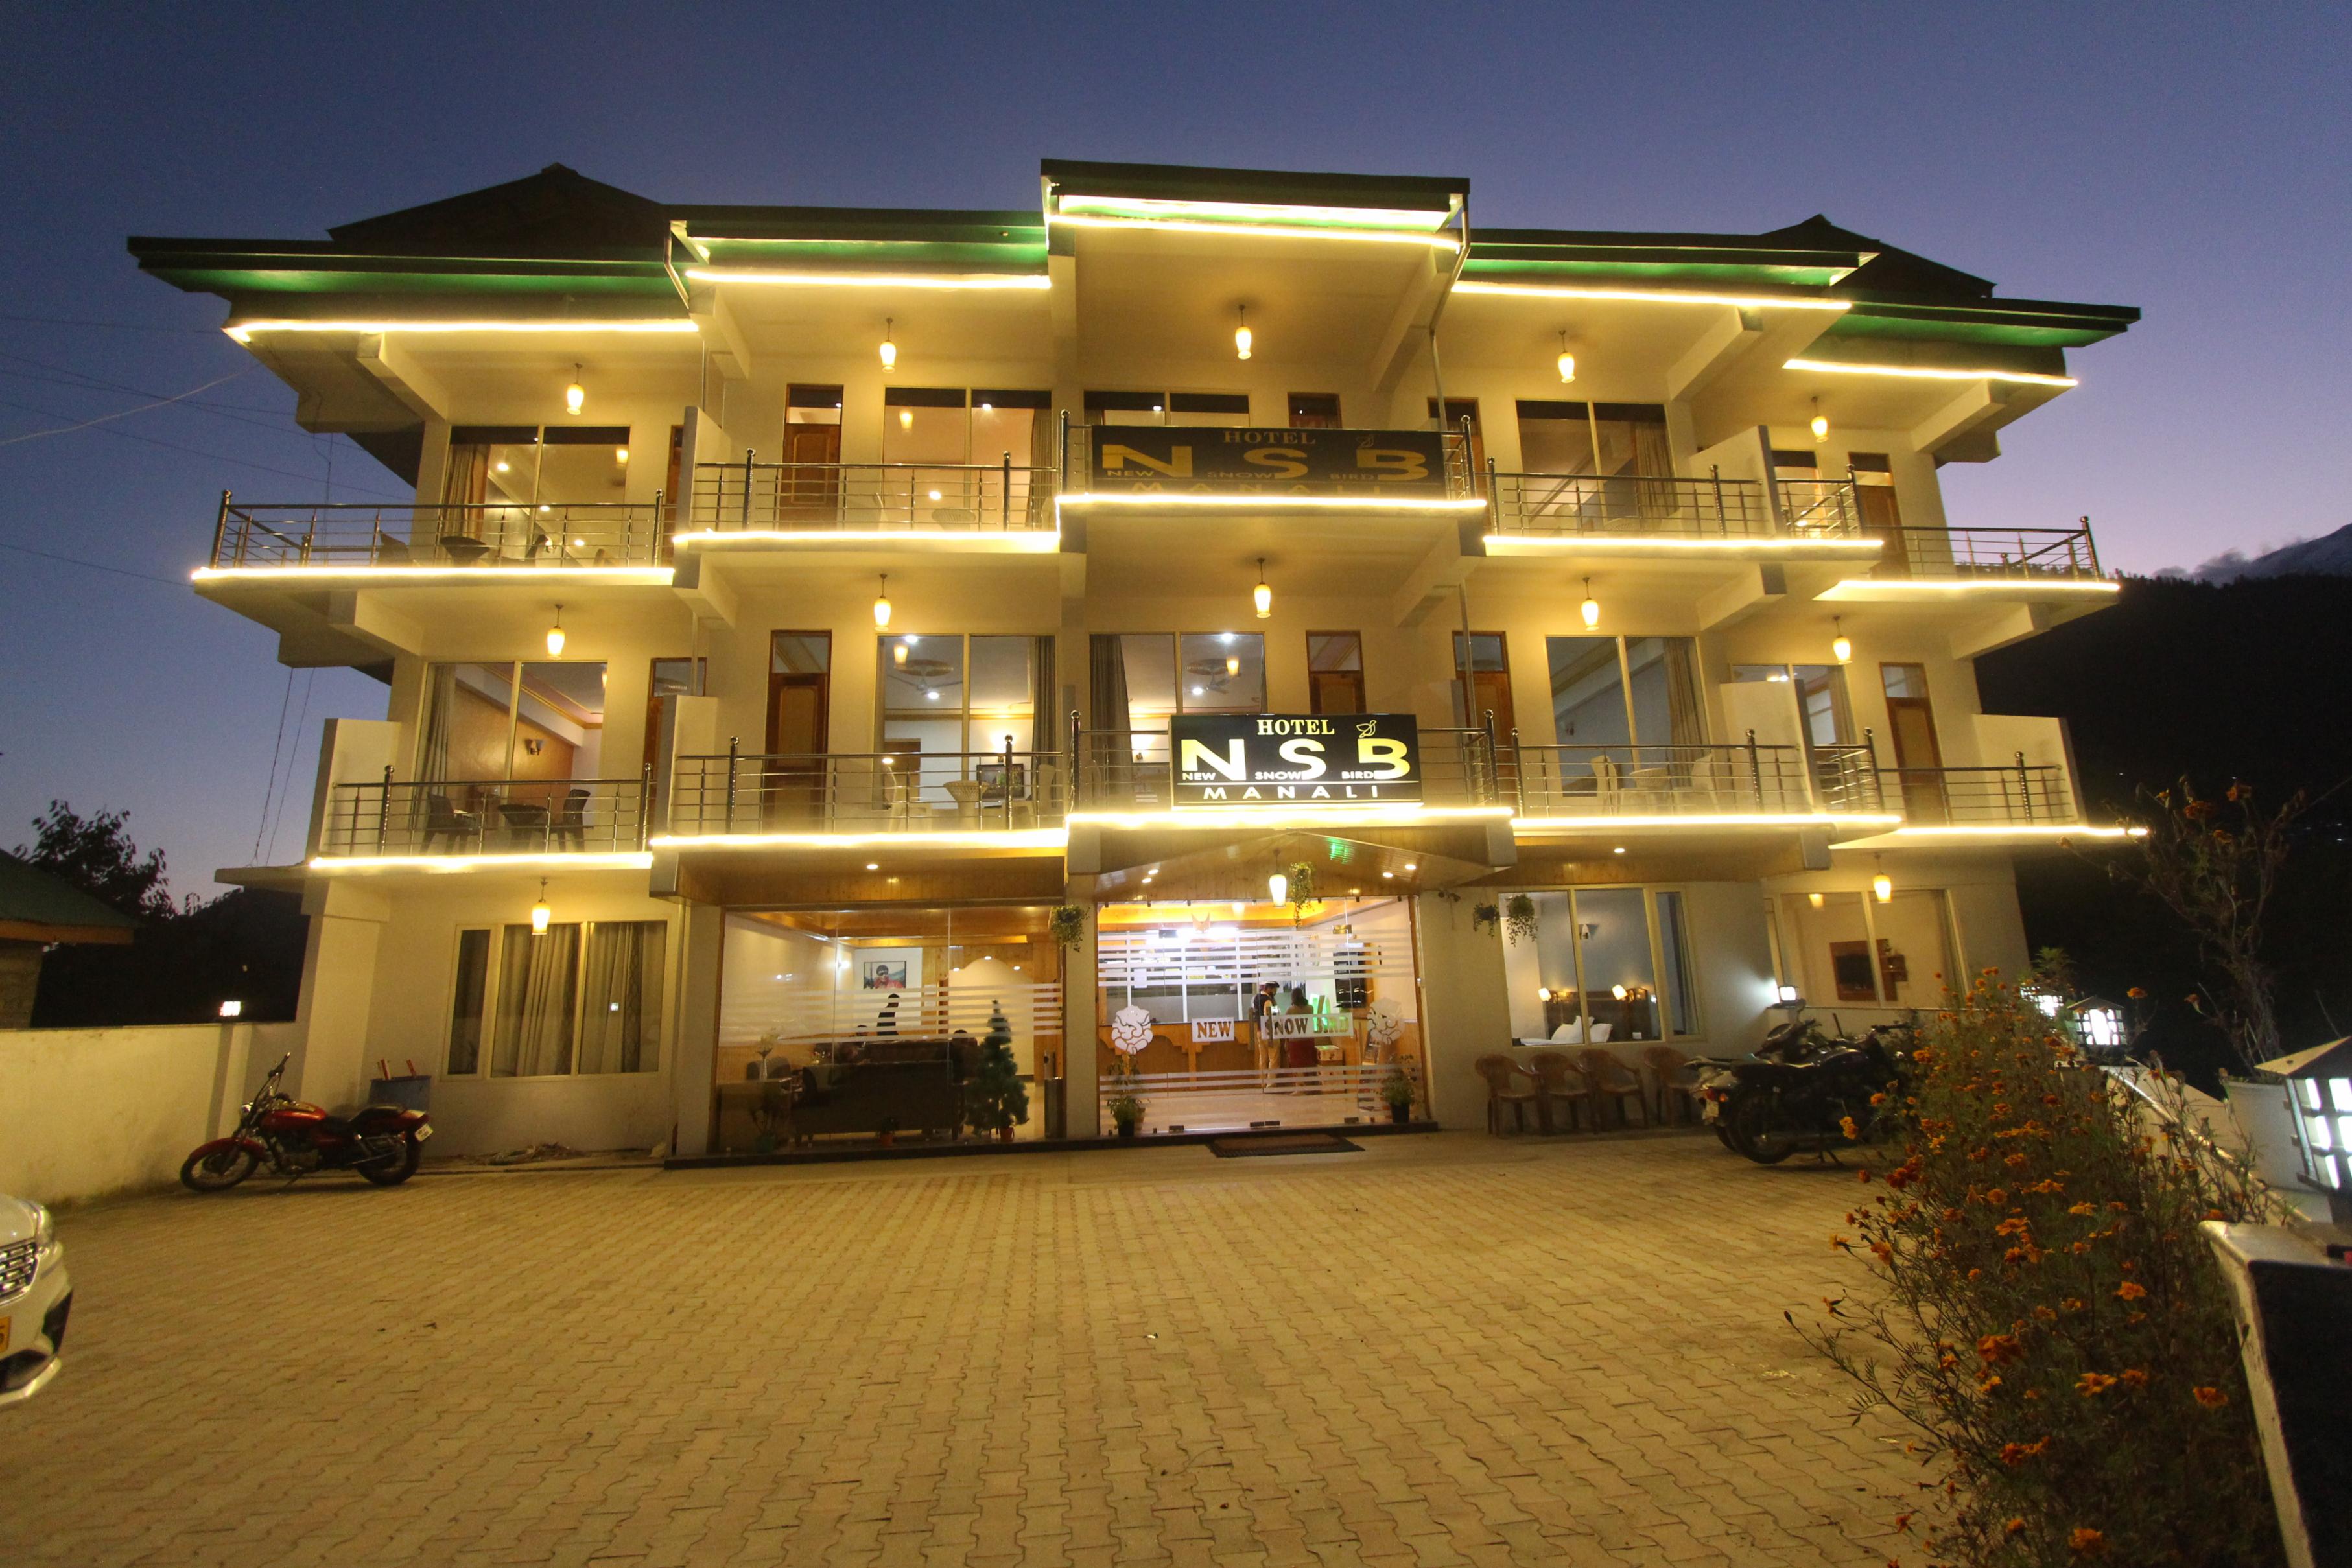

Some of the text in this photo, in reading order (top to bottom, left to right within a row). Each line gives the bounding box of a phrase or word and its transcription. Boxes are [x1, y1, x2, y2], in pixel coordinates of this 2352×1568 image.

[1223, 430, 1316, 445] HOTEL
[1256, 719, 1335, 736] HOTEL
[1182, 771, 1374, 781] NEW SNOW BIRD
[1203, 785, 1378, 799] MANALI
[1197, 1016, 1350, 1038] NEW SNOW BIRD
